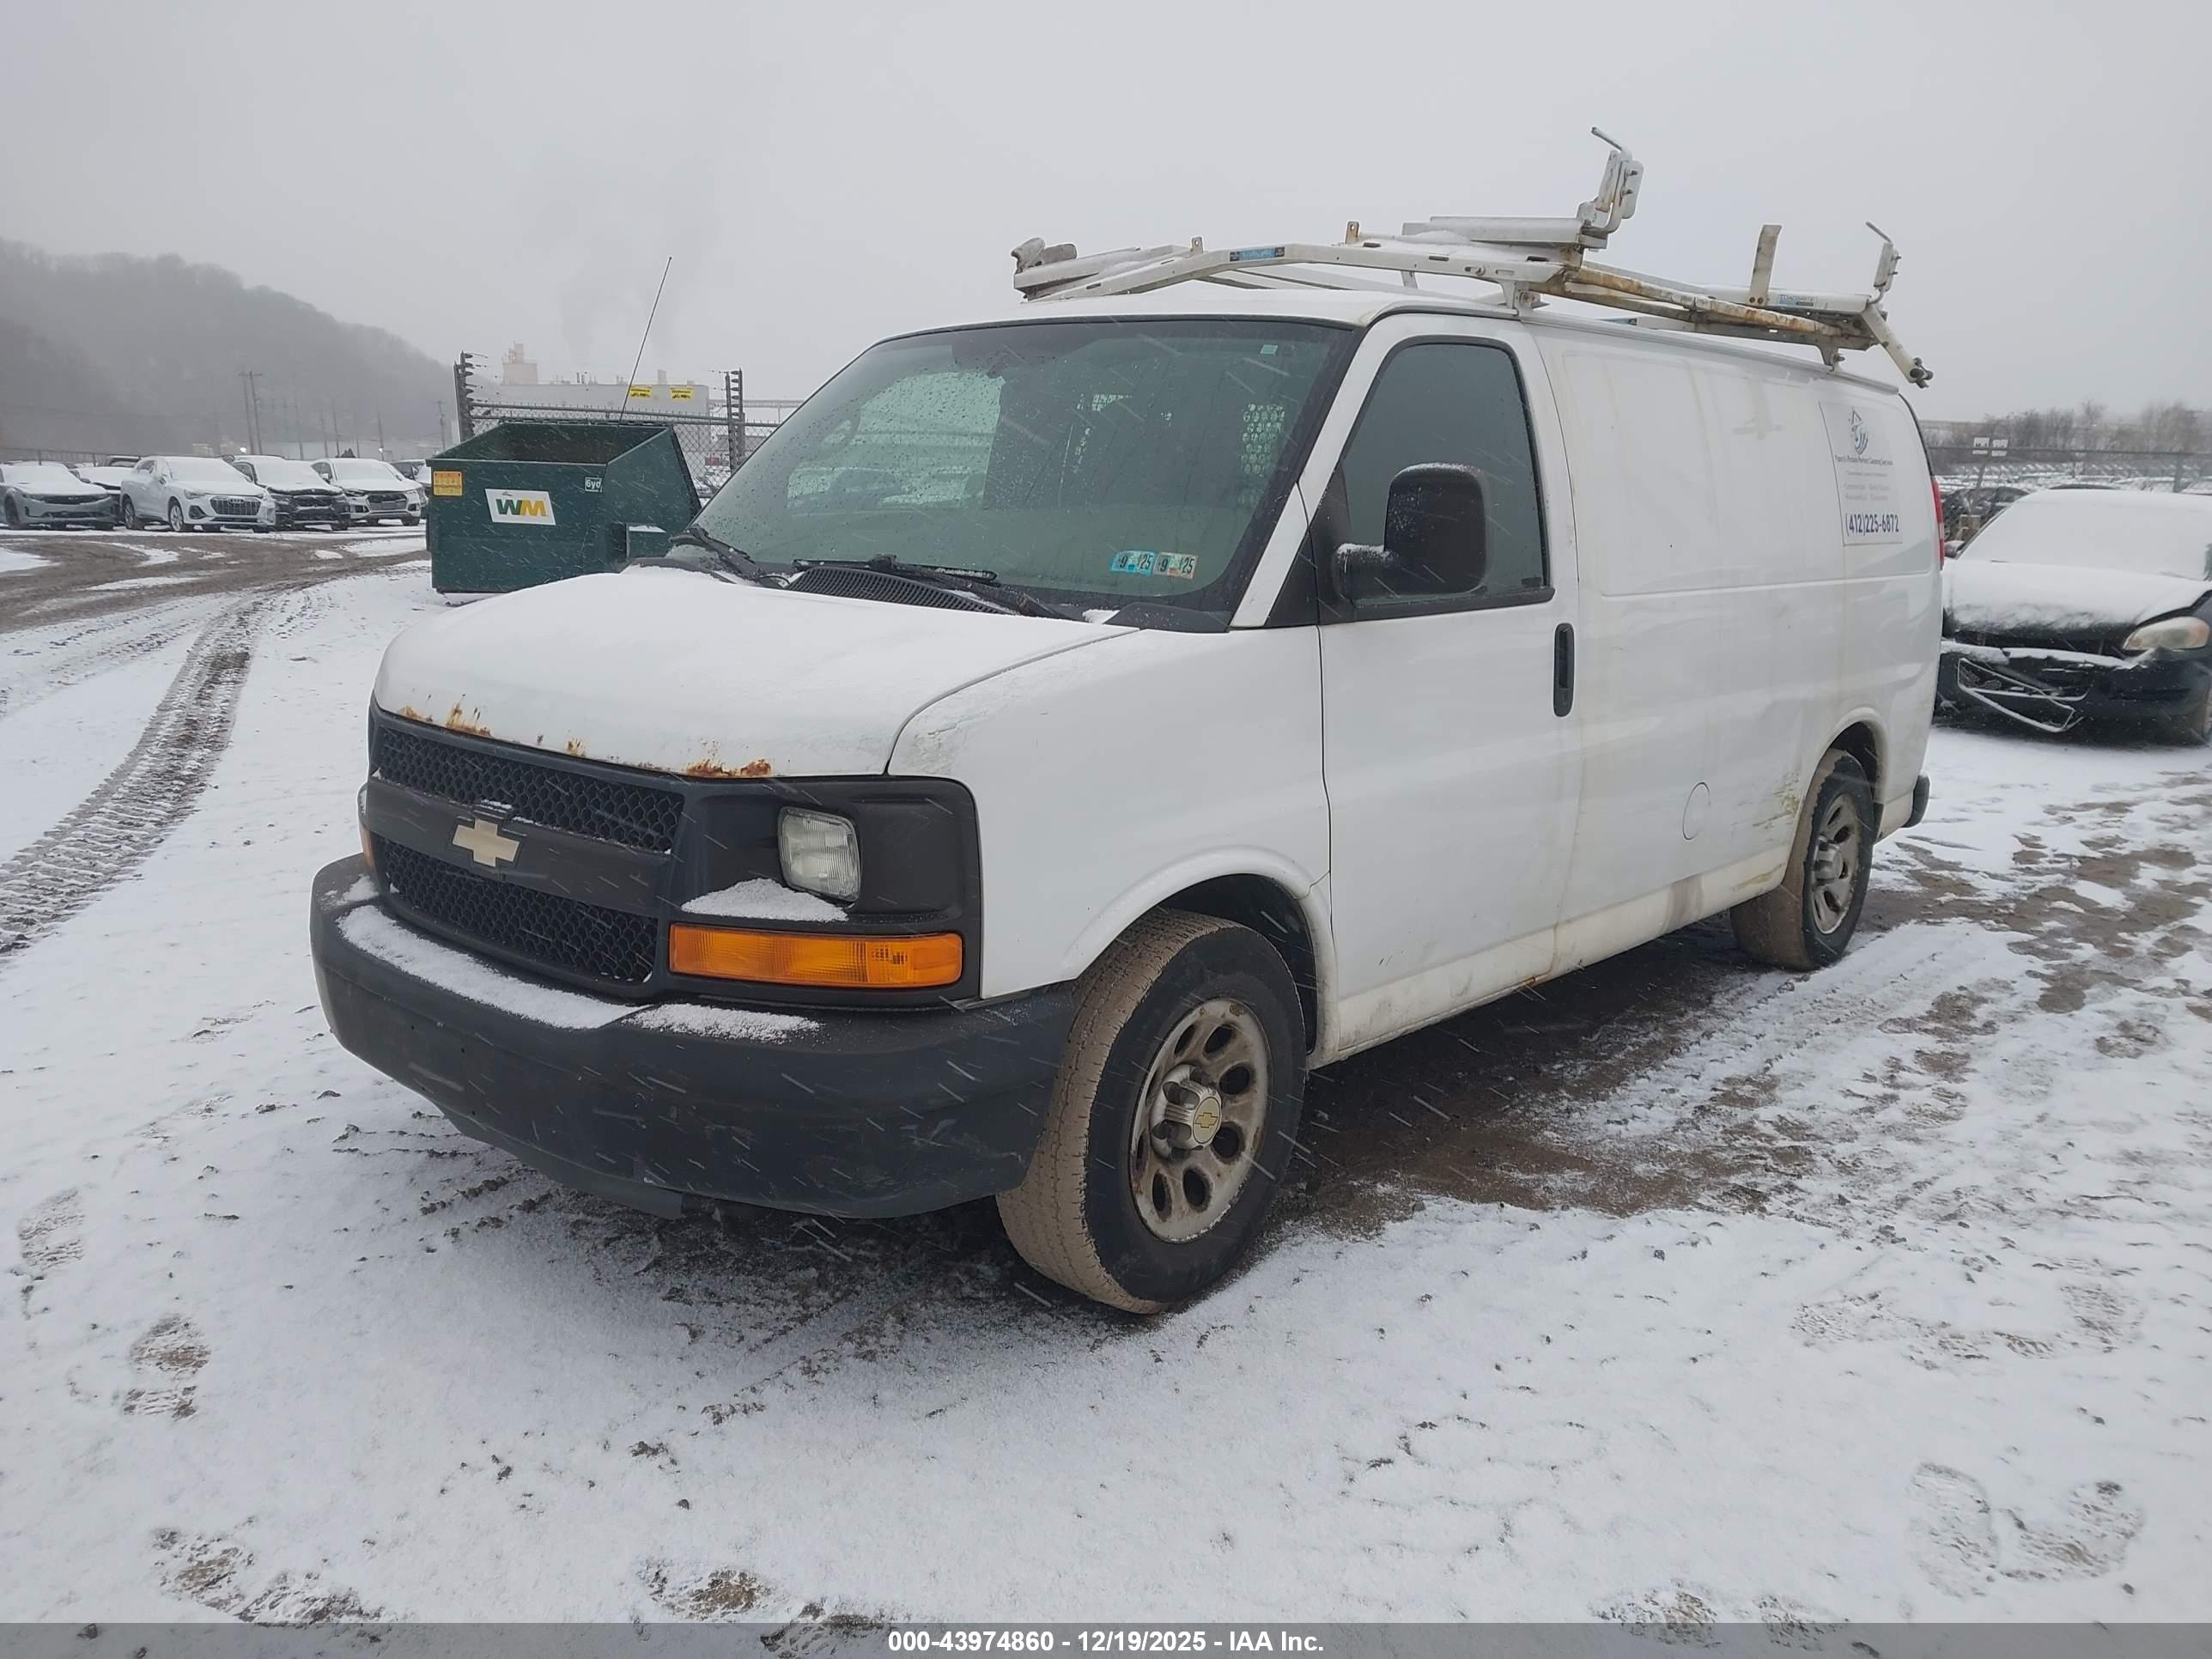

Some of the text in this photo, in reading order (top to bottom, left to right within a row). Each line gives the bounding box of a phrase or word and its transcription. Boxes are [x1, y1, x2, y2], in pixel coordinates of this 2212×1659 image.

[586, 479, 601, 489] 6yd
[495, 498, 548, 517] WM
[1845, 513, 1899, 537] (412)225-6872
[1140, 554, 1154, 569] 25
[1182, 557, 1195, 574] 25
